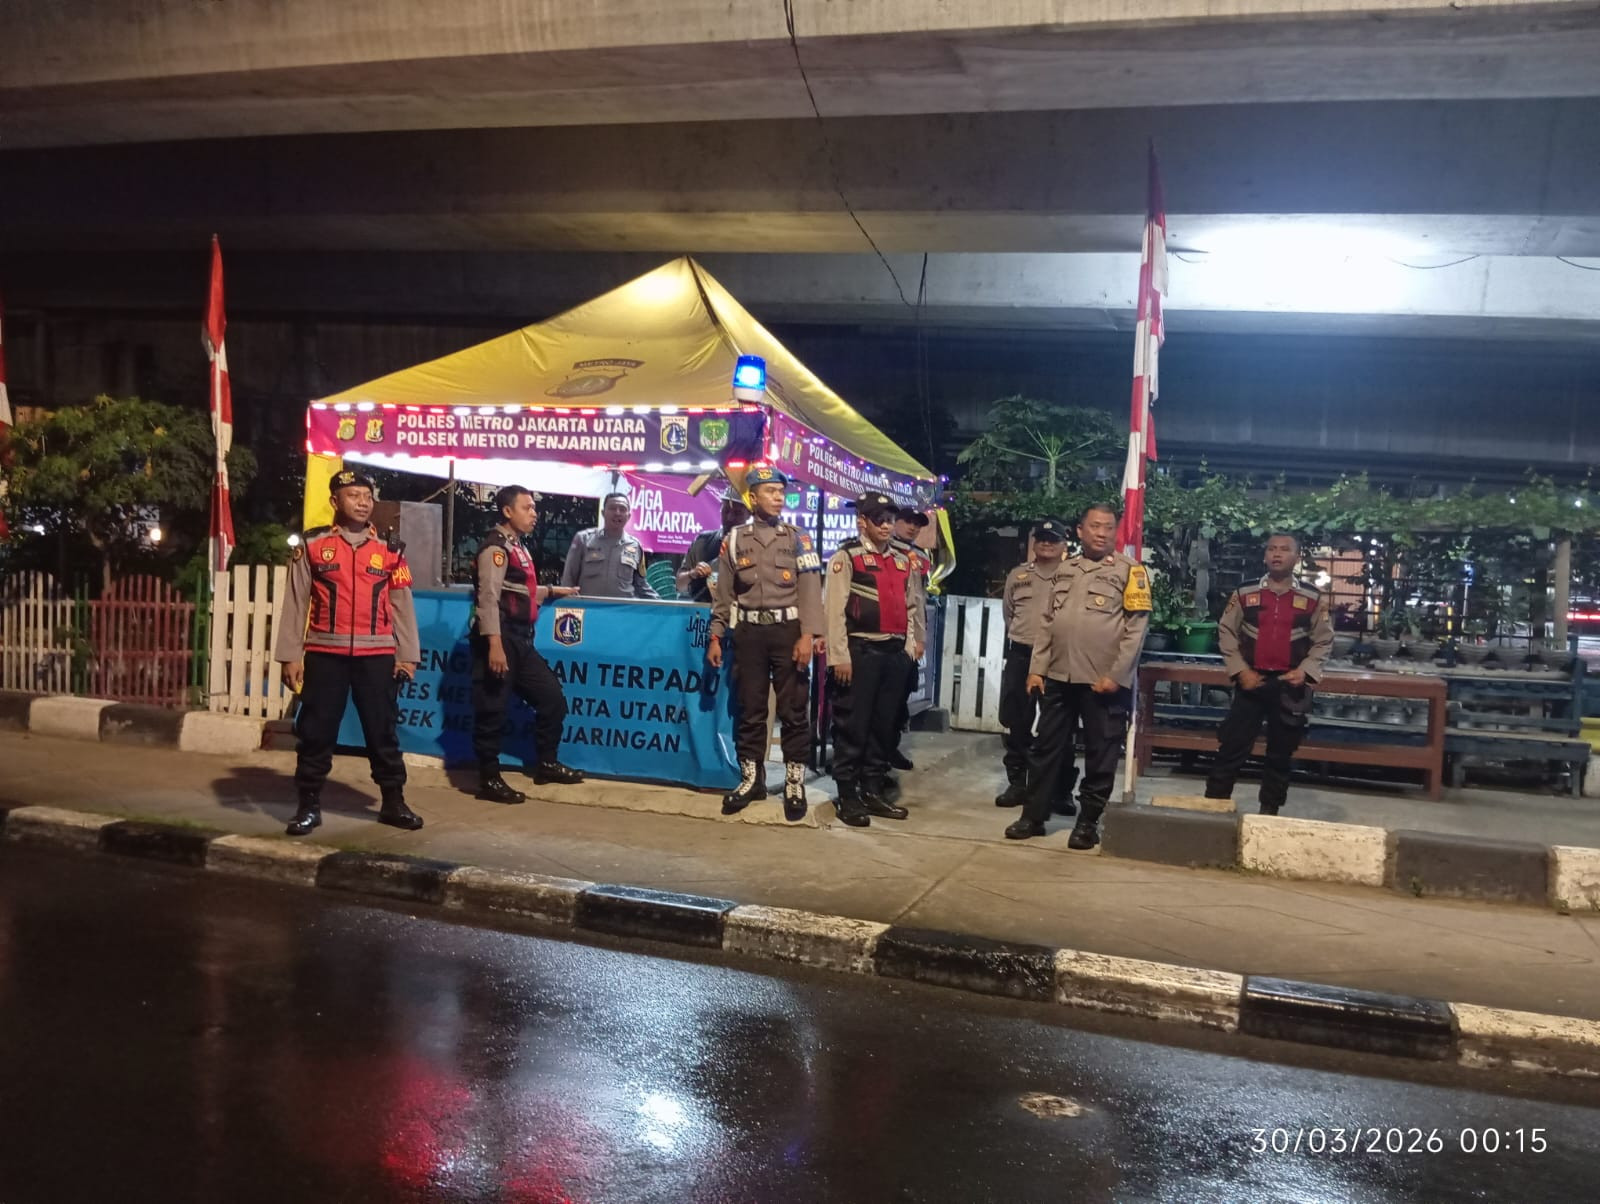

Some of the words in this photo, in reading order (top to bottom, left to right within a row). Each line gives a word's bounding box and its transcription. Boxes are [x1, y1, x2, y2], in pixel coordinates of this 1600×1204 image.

[397, 414, 455, 430] POLRES
[460, 415, 513, 431] METRO
[518, 416, 588, 433] JAKARTA
[593, 418, 646, 433] UTARA
[396, 431, 458, 446] POLSEK
[463, 432, 518, 448] METRO
[524, 434, 646, 451] PENJARINGAN
[809, 443, 837, 468] POLRES
[807, 461, 838, 485] POLSEK
[839, 475, 865, 495] METRO
[629, 484, 663, 511] JAGA
[597, 663, 721, 697] TERPADU
[620, 700, 689, 724] UTARA
[396, 708, 436, 729] SEK
[562, 725, 681, 753] JARINGAN
